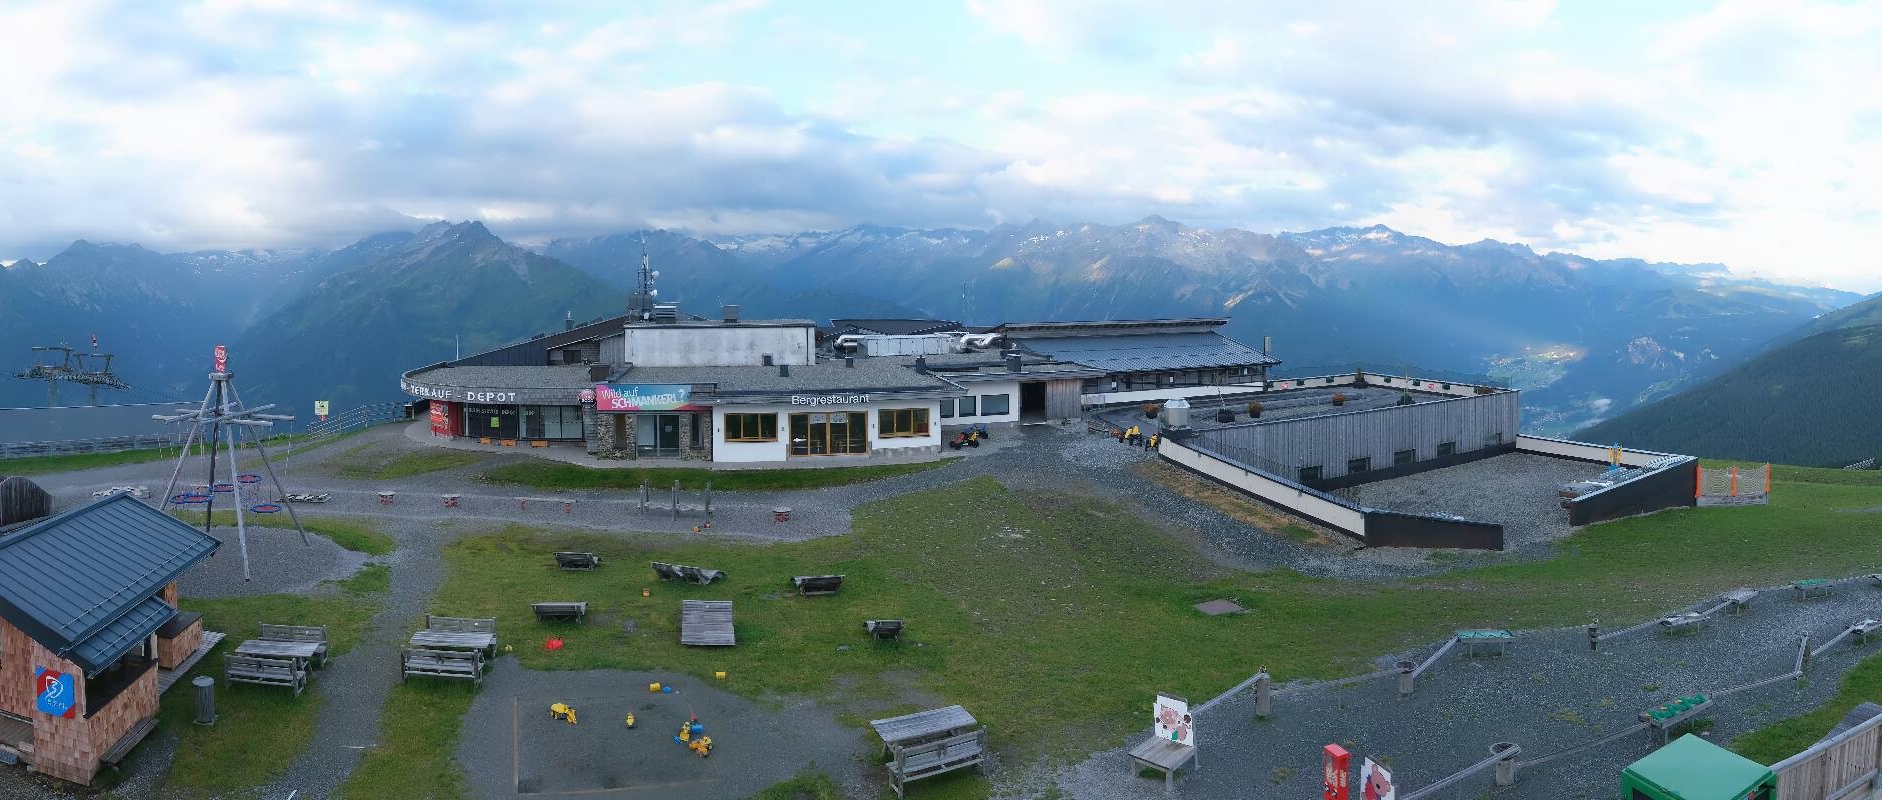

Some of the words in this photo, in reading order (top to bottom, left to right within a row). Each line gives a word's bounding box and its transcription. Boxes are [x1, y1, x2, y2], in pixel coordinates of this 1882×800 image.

[467, 391, 516, 402] DEPOT
[601, 387, 622, 400] Wild
[623, 386, 639, 397] auf
[791, 394, 870, 407] Bergrestaurant
